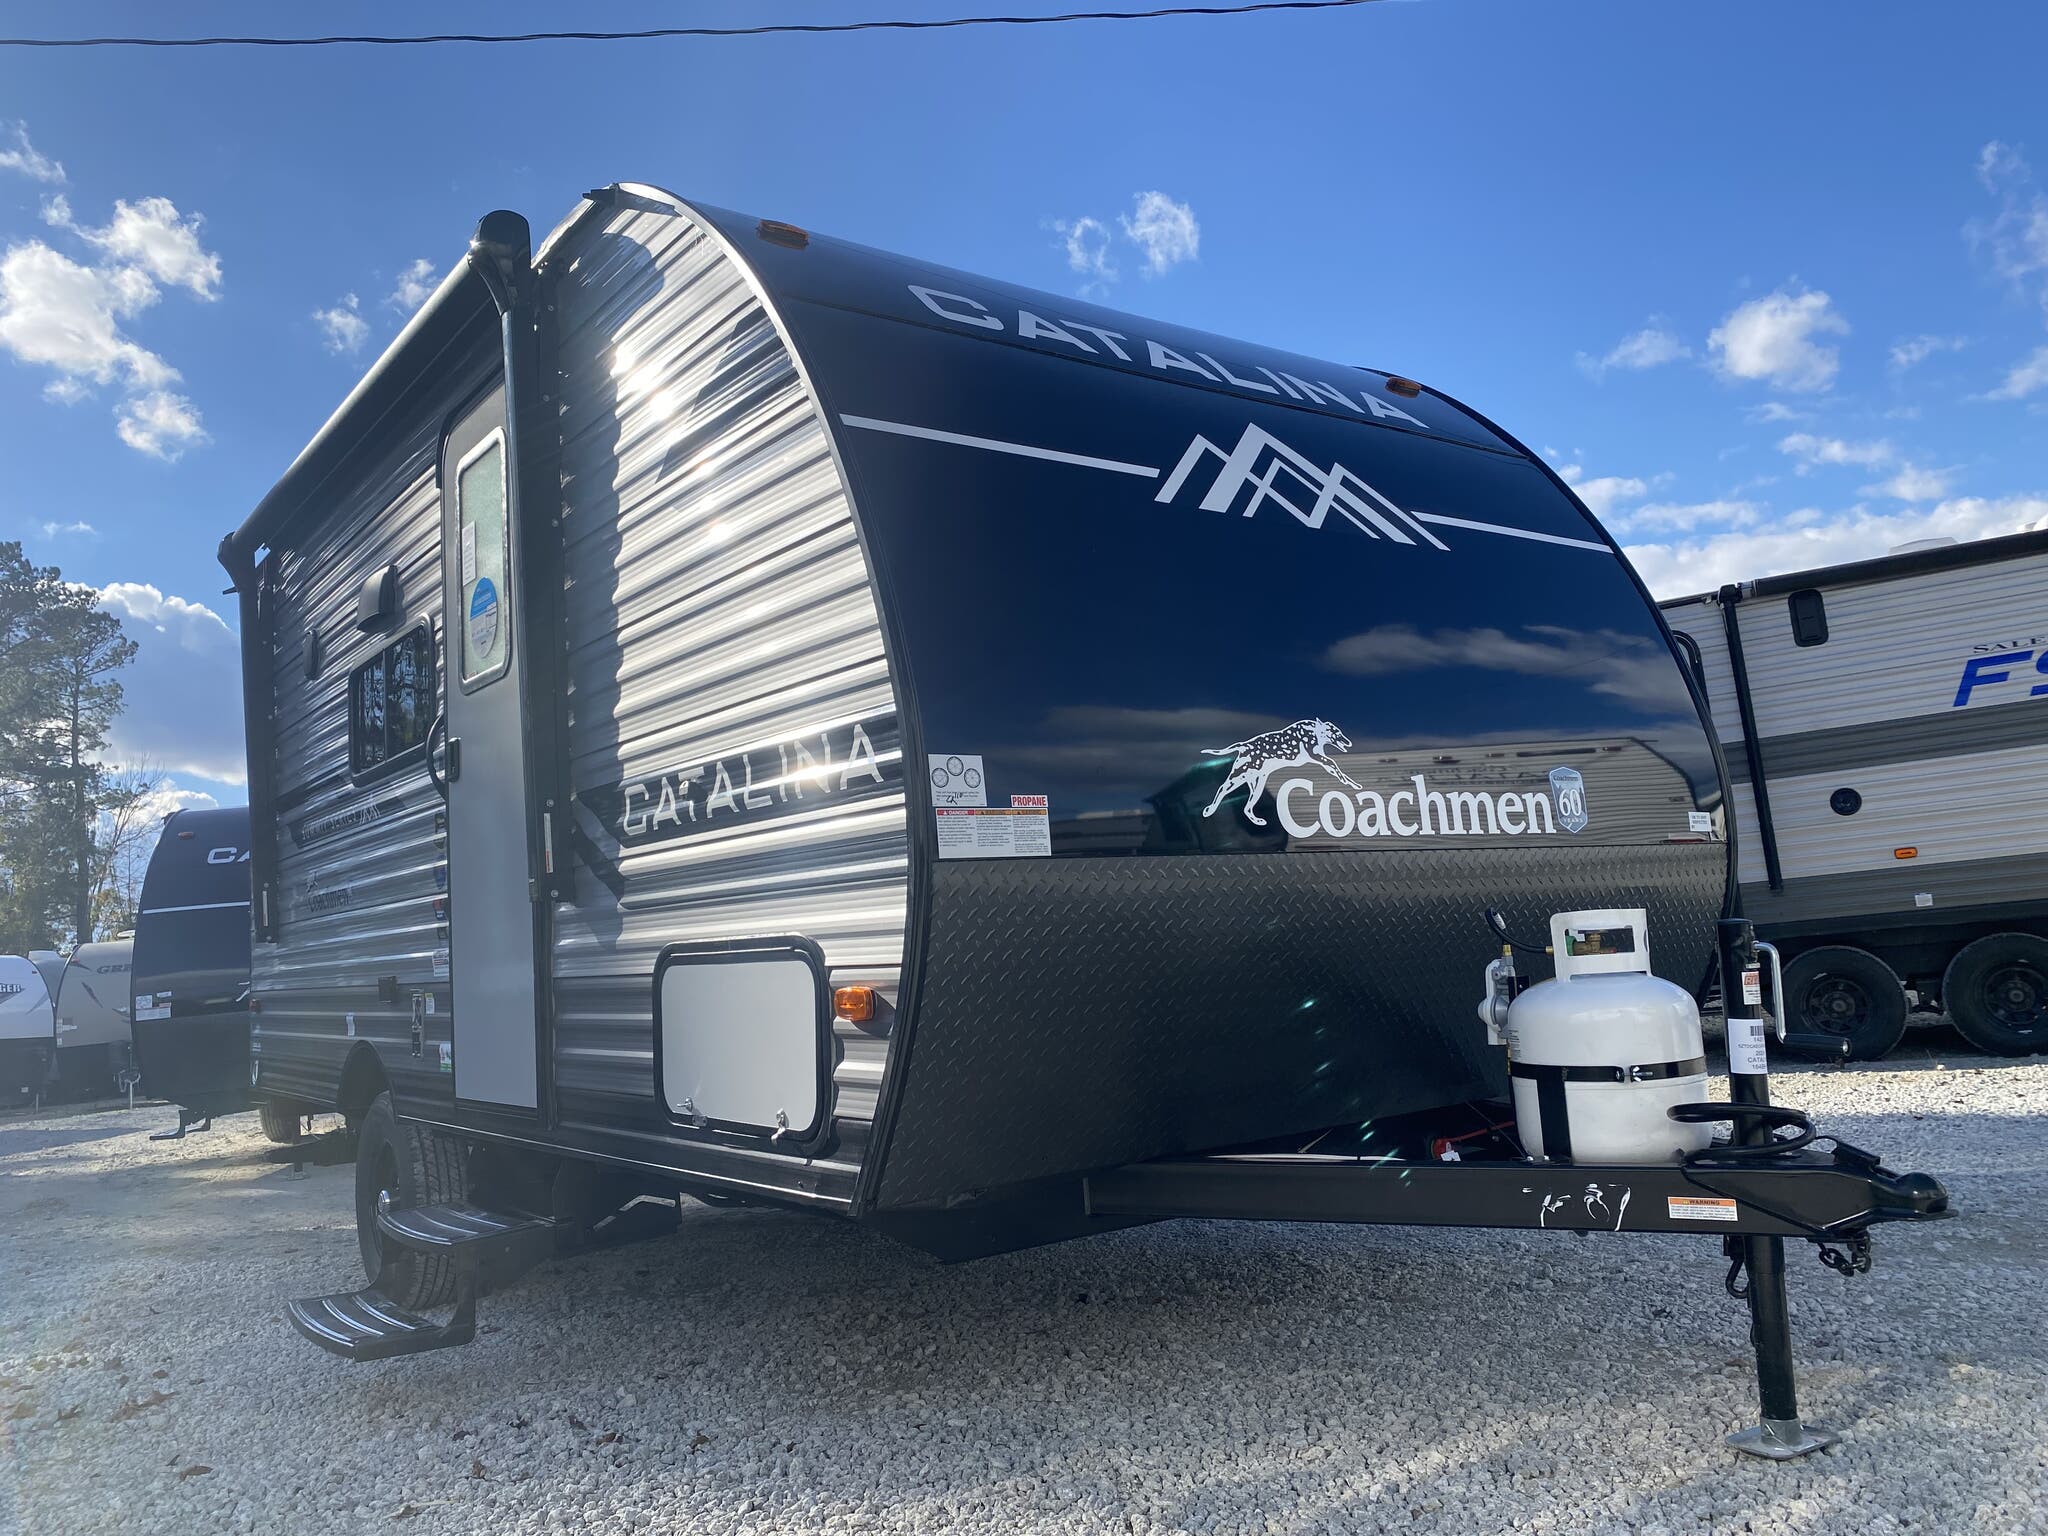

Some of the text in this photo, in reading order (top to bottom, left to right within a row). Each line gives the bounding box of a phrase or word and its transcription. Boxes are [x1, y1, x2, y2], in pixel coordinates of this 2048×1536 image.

[907, 285, 1431, 429] CATALINA
[623, 723, 885, 836] CATALINA
[1012, 796, 1047, 807] PROPANE
[1276, 774, 1557, 839] Coachmen
[1559, 789, 1582, 816] 60
